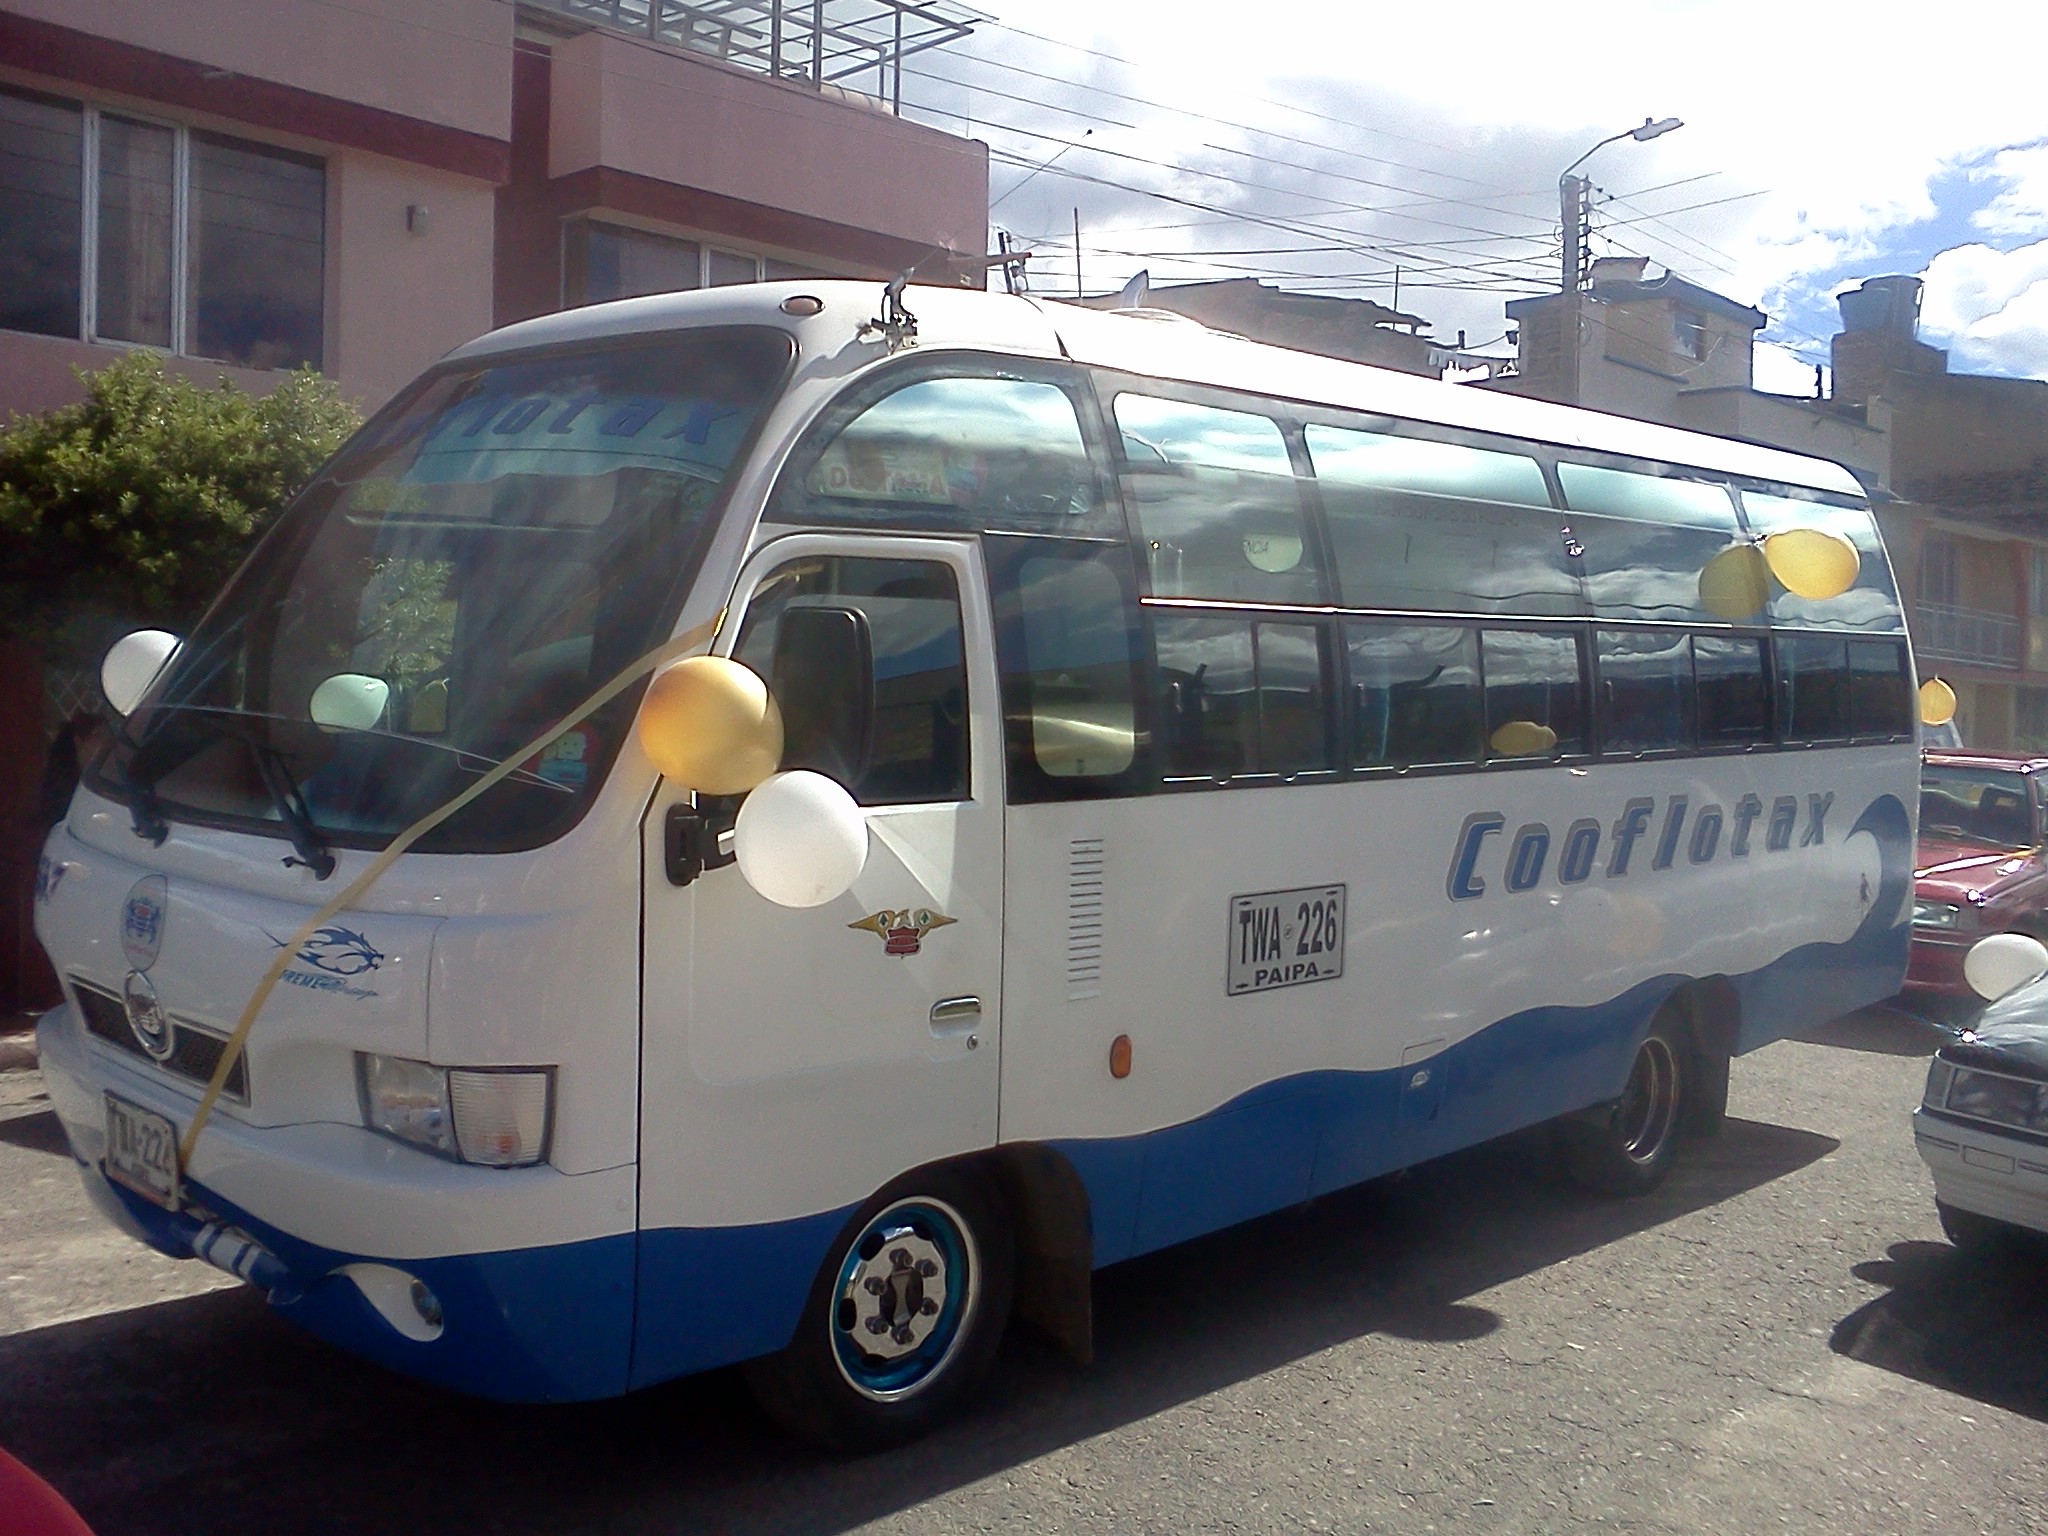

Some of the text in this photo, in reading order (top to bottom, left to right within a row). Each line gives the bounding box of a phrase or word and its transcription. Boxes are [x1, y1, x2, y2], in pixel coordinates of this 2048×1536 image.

[1446, 793, 1835, 902] Cooflotax
[1239, 899, 1337, 965] TWA 226
[1255, 961, 1319, 987] PAIPA
